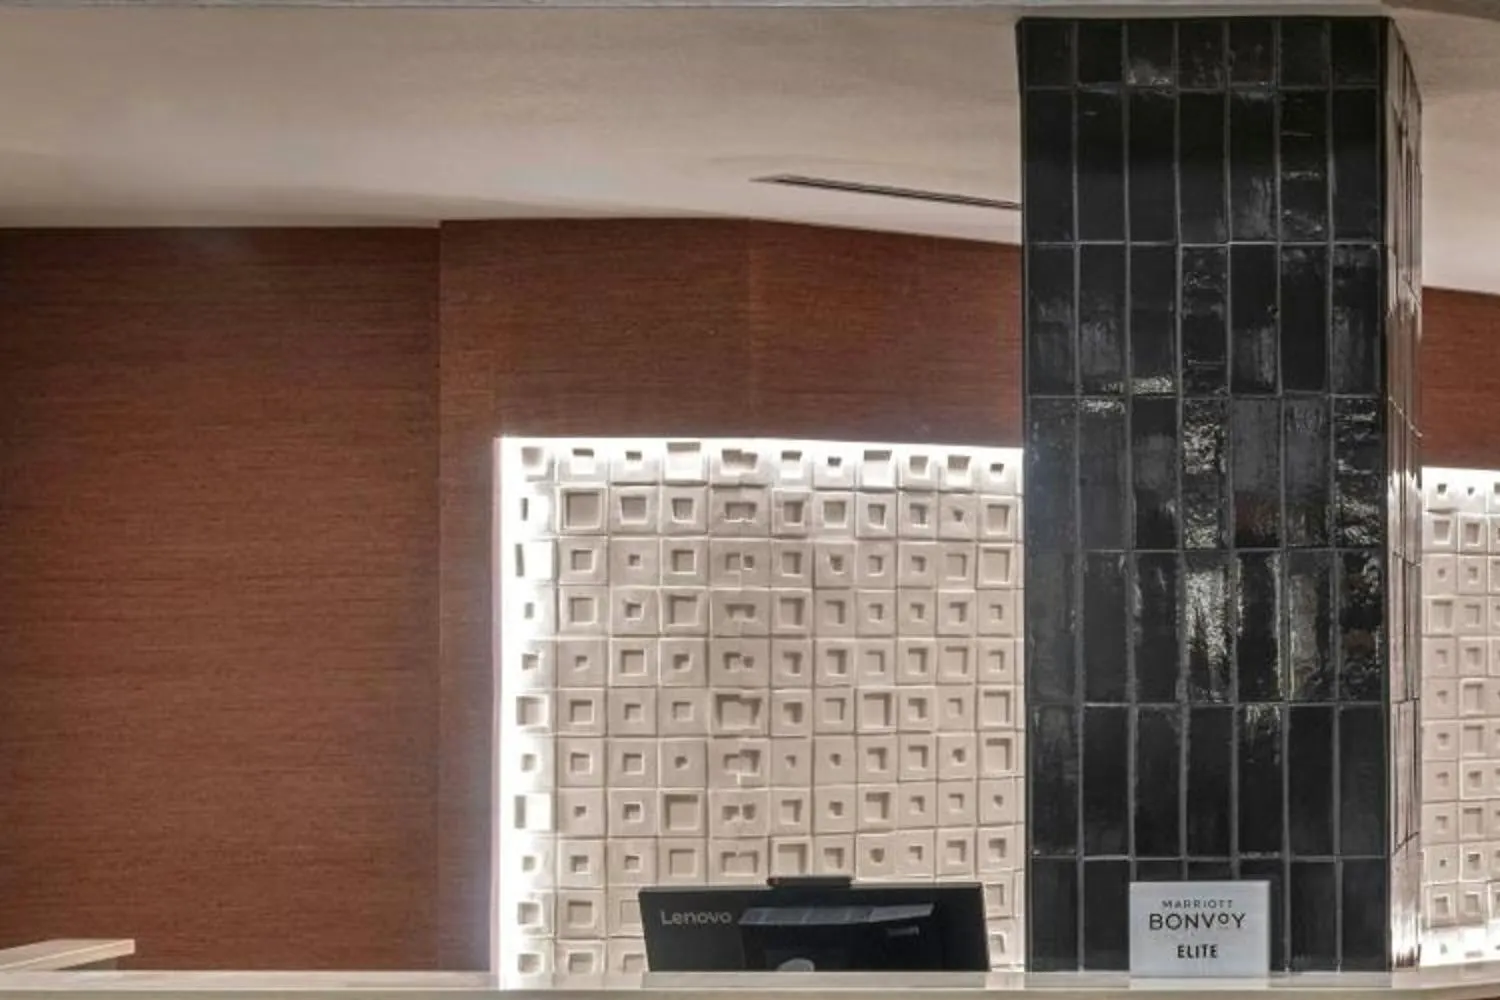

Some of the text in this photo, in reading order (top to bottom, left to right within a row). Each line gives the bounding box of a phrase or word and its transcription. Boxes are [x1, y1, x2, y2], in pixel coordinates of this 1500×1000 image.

[1162, 900, 1233, 908] MARRIOTT
[661, 911, 732, 925] Lenovo
[1149, 913, 1245, 930] BONVOY
[1177, 944, 1218, 959] ELITE
